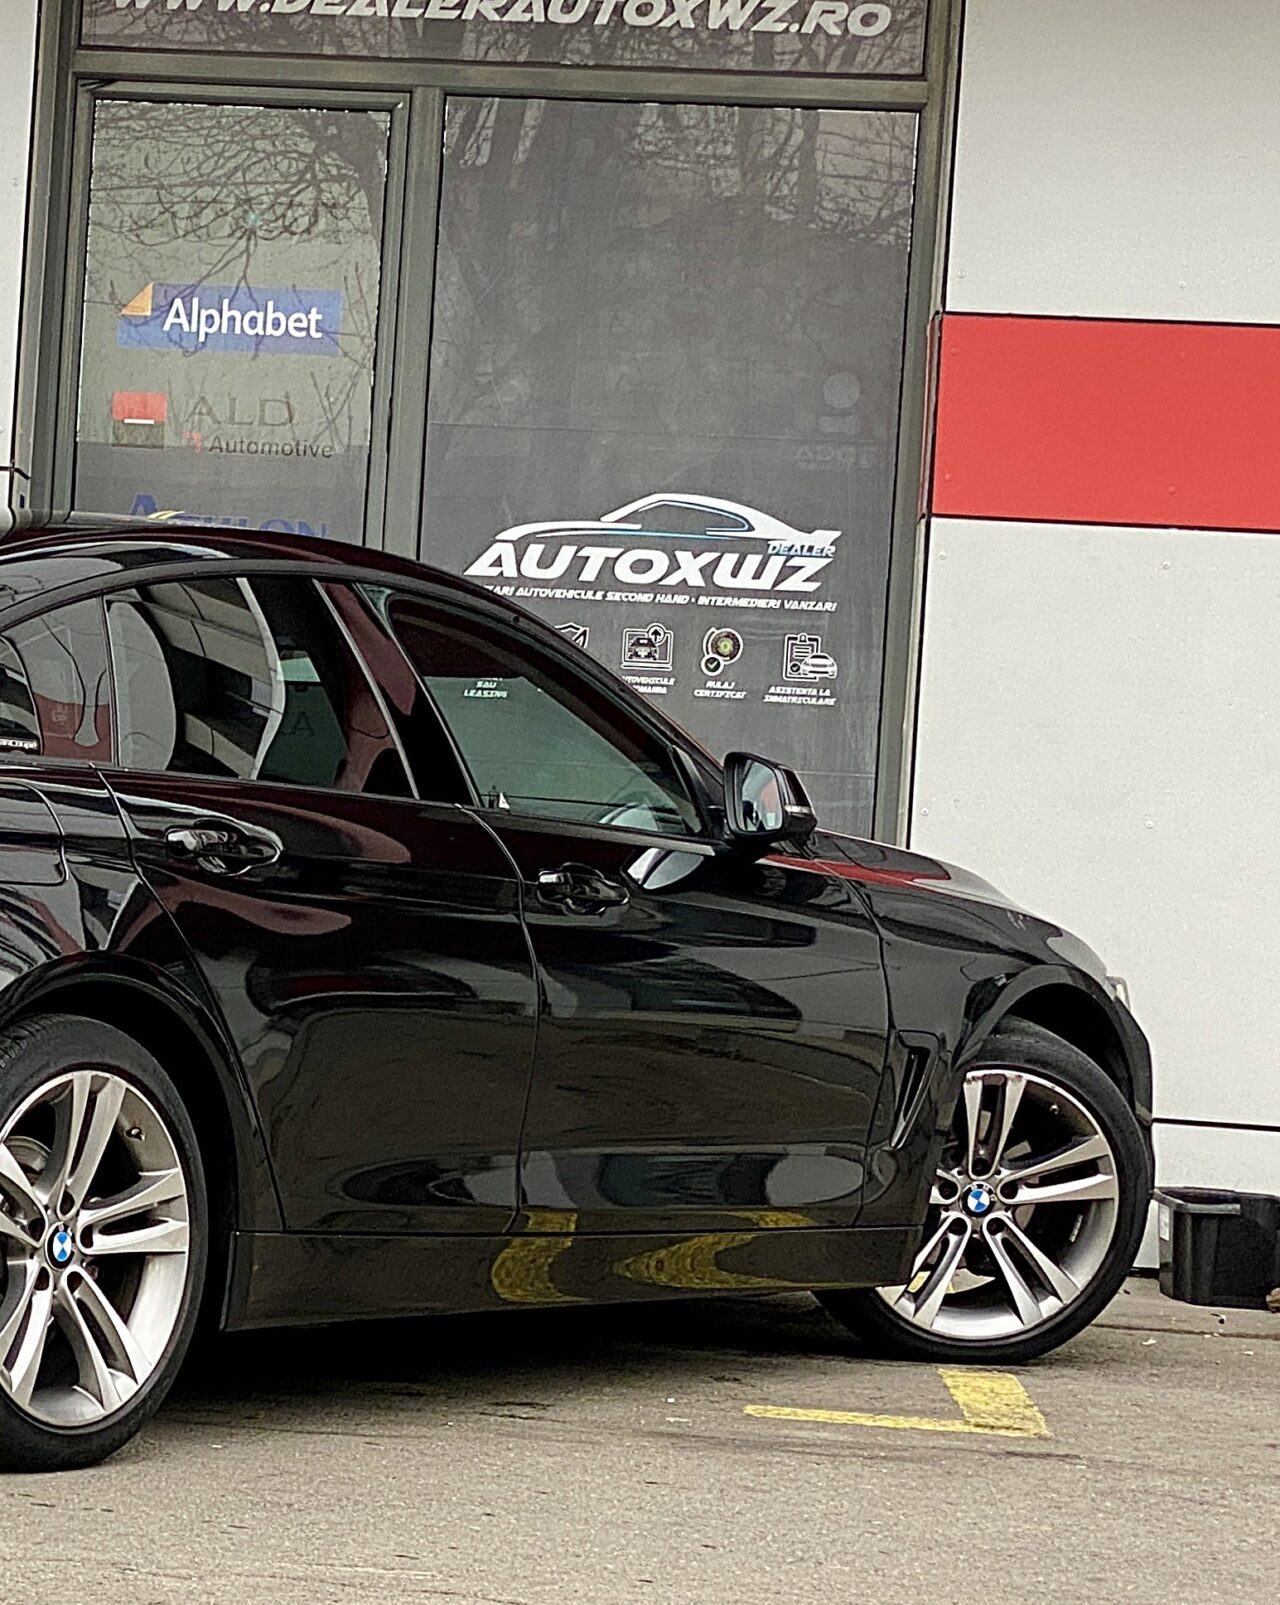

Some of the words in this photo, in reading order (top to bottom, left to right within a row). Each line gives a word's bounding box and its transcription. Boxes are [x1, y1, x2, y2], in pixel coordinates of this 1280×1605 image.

[162, 298, 323, 342] Alphabet
[208, 435, 334, 459] Automotive
[767, 540, 837, 557] DEALER
[464, 543, 834, 592] AUTOXWZ
[516, 587, 604, 601] AUTOVEHICULE
[605, 591, 653, 603] SECOND
[655, 594, 690, 606] HAND
[697, 596, 781, 609] INTERMEDIERI
[783, 600, 837, 612] VANZARI
[464, 689, 508, 698] LEASING
